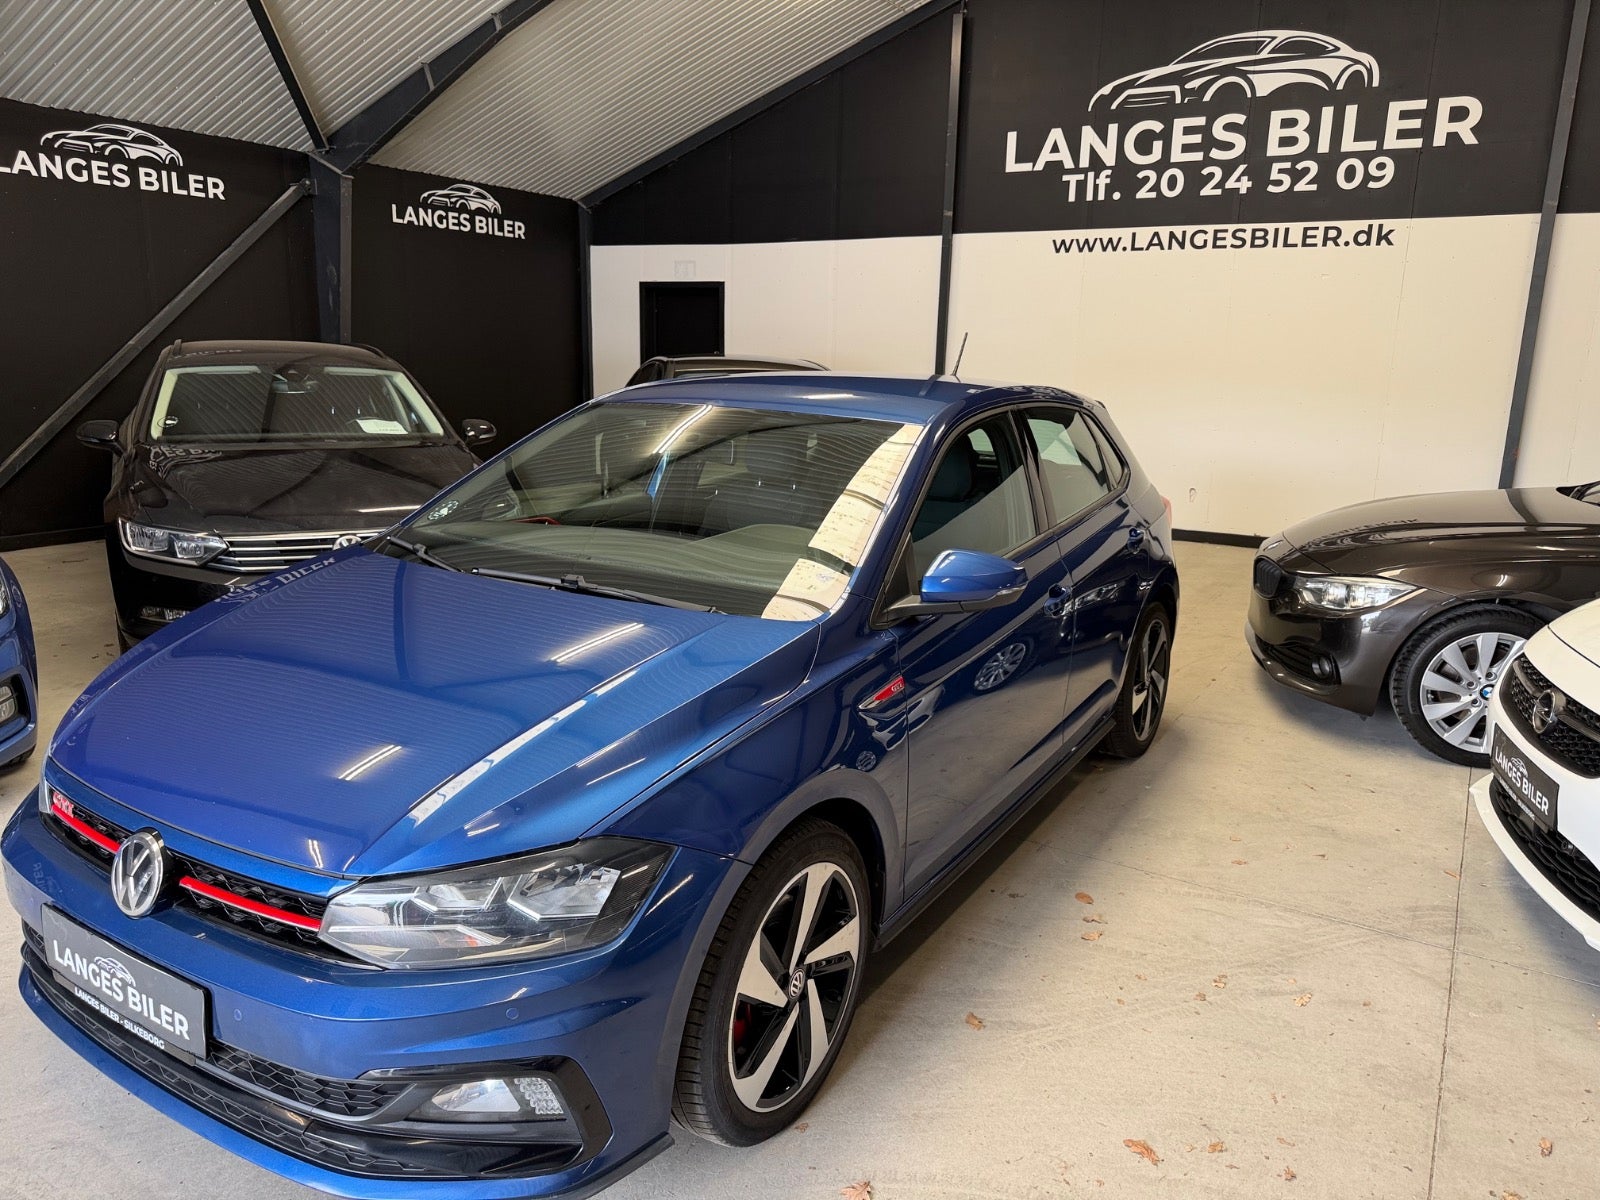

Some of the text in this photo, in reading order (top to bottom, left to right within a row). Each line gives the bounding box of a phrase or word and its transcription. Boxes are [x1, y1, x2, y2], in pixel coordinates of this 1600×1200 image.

[1005, 95, 1484, 173] LANGES BILER
[139, 168, 226, 200] BILER
[1062, 155, 1396, 203] Tlf. 20 24 52 09
[391, 203, 526, 240] LANGES BILER
[1051, 222, 1396, 254] www.LANGESBILER.dk
[1495, 746, 1522, 788] LANGES
[1522, 777, 1549, 816] BILER
[53, 939, 190, 1041] LANGES BILER
[74, 986, 101, 1010] LANGES
[100, 1004, 121, 1024] BILER
[124, 1018, 166, 1050] SILKEBORG
